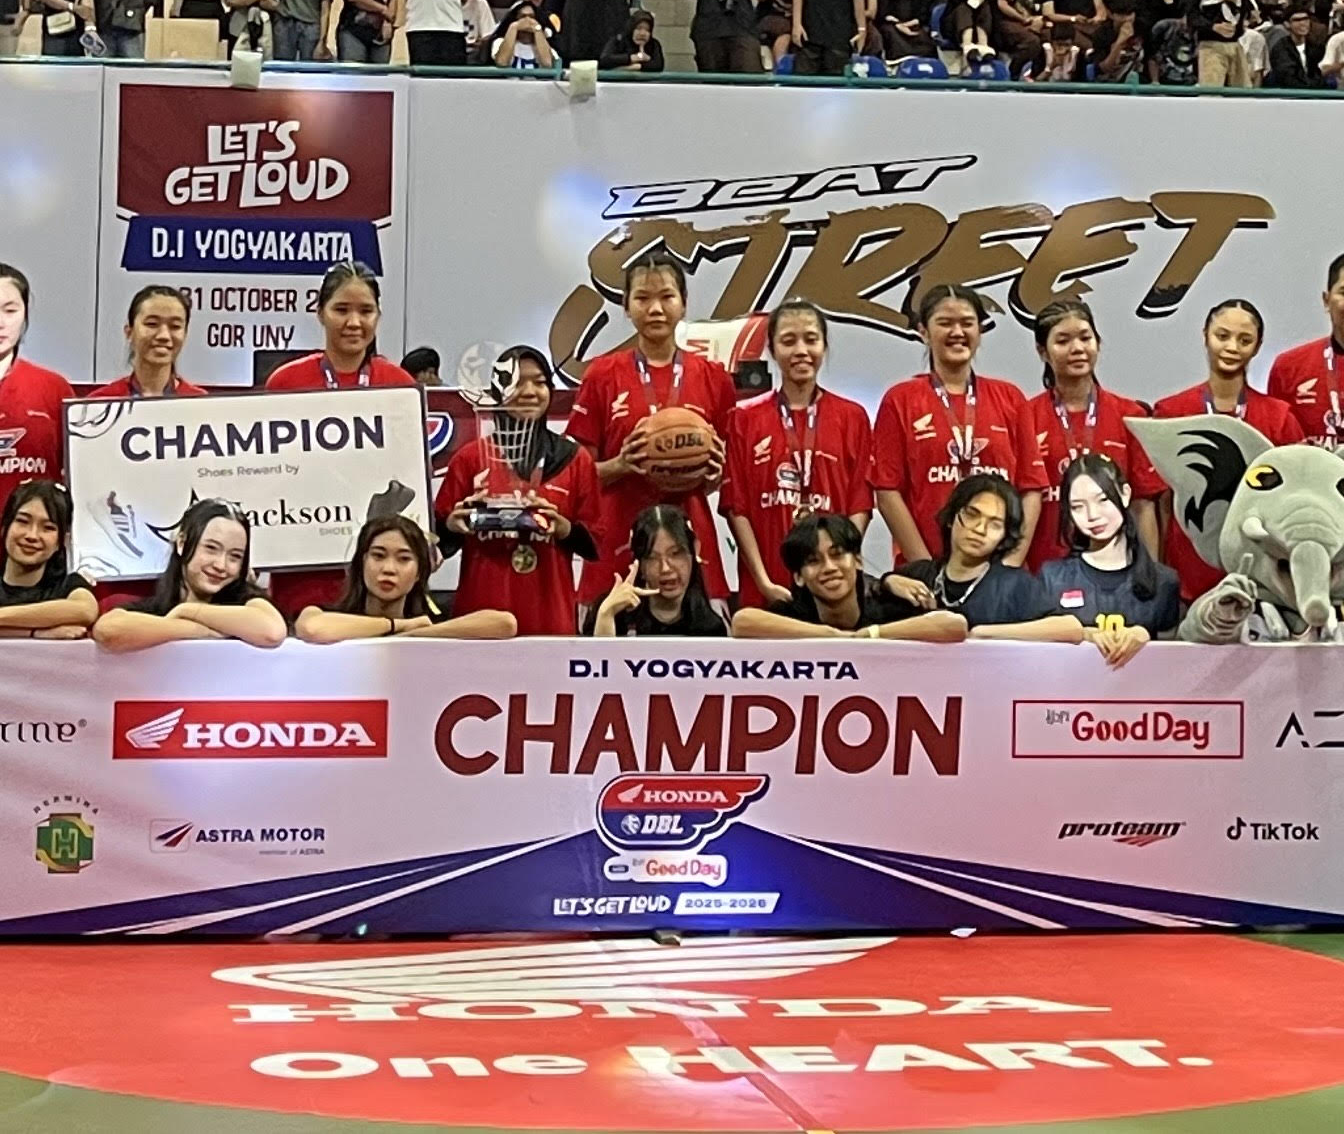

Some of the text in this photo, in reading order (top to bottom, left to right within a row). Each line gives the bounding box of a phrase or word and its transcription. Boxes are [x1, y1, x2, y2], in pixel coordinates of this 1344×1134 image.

[206, 119, 301, 165] LET'S
[195, 229, 353, 263] YOGYAKARTA
[211, 289, 297, 313] OCTOBER
[207, 323, 295, 349] GOR UNY
[120, 415, 386, 463] CHAMPION
[197, 464, 300, 478] Shoes Reward by
[625, 659, 859, 681] YOGYAKARTA
[182, 722, 377, 750] HONDA
[434, 692, 964, 778] CHAMPION
[642, 790, 729, 804] HONDA
[195, 827, 326, 843] ASTRA MOTOR
[640, 815, 684, 835] DBL
[1058, 821, 1181, 840] proteam
[1250, 822, 1320, 841] TikTok
[230, 994, 1113, 1024] HONDA
[249, 1051, 591, 1081] One
